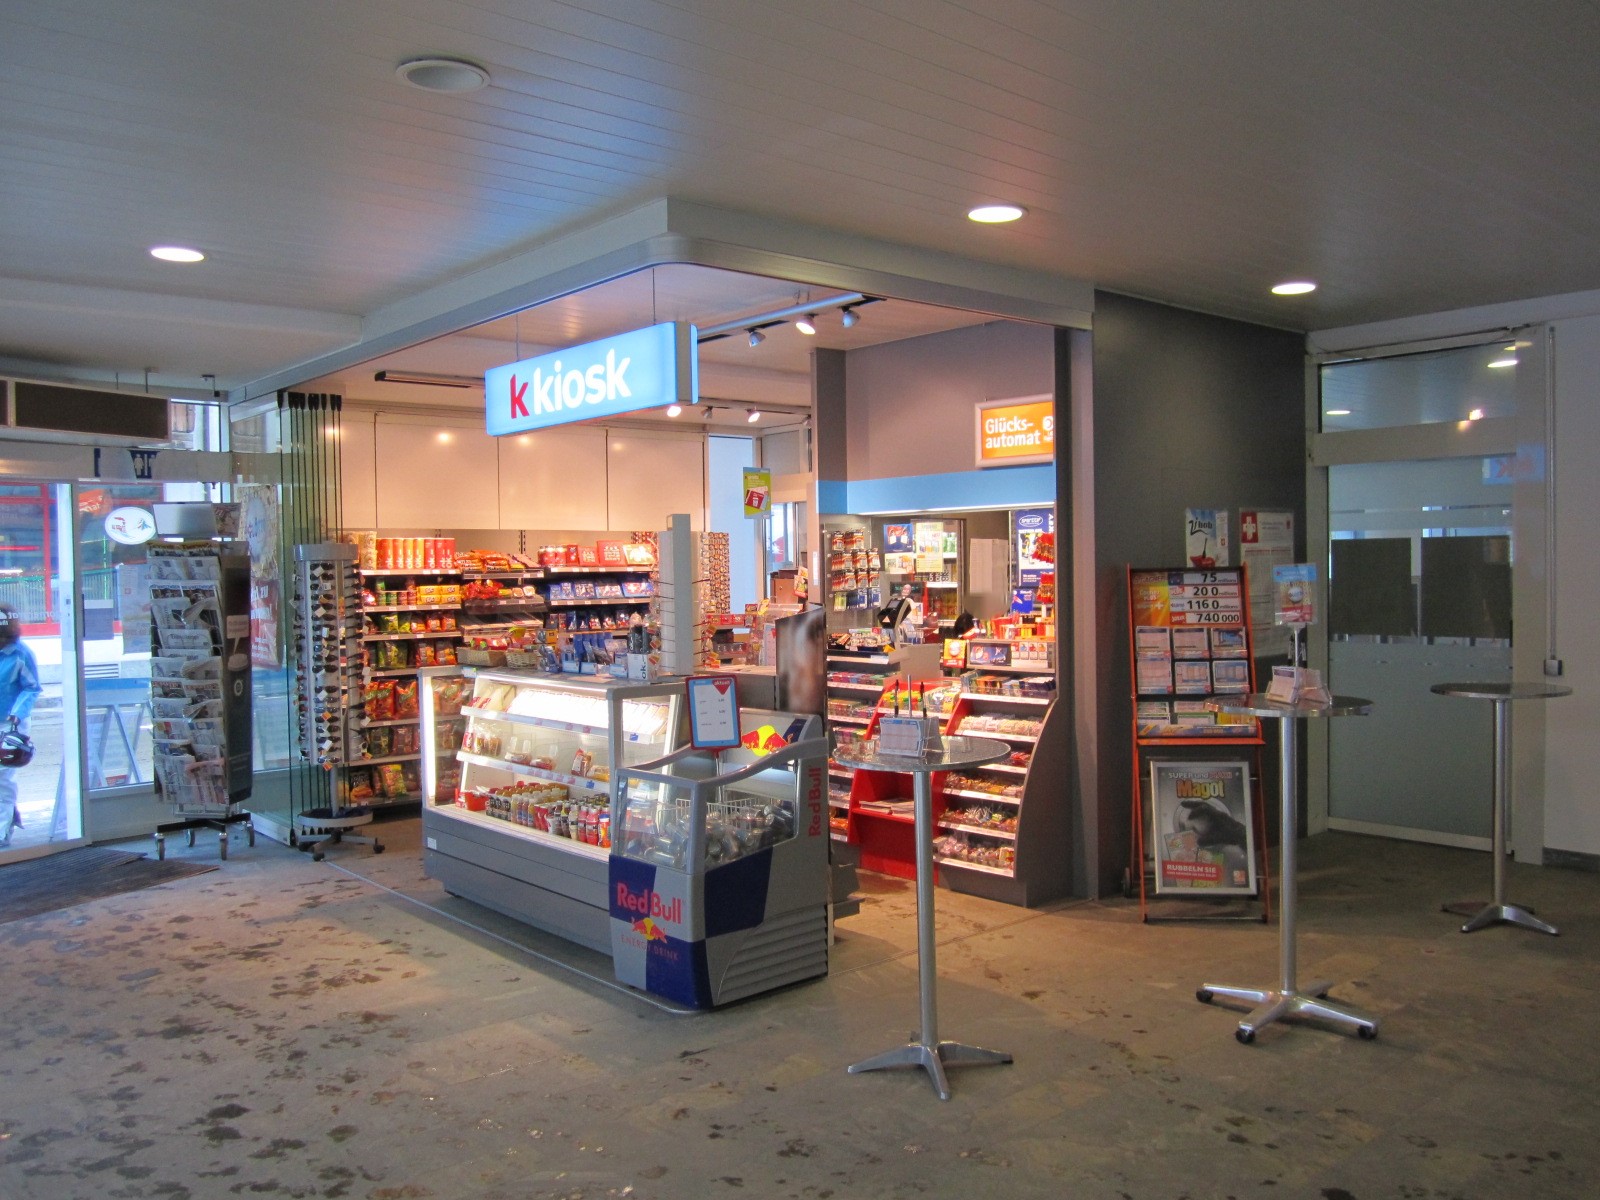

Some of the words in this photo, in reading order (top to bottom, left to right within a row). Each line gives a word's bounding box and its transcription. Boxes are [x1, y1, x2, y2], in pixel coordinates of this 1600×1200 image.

[510, 374, 530, 419] k
[533, 348, 632, 415] kiosk
[985, 415, 1034, 434] Glücks-
[985, 430, 1041, 449] automat
[1201, 572, 1217, 583] 75
[1196, 613, 1220, 623] 740
[1221, 614, 1240, 622] 000
[808, 768, 822, 800] Bull
[1176, 779, 1225, 800] Magot
[808, 802, 822, 836] Red
[1166, 864, 1204, 872] RUBBELN
[617, 881, 648, 914] Red
[650, 891, 683, 925] Bull
